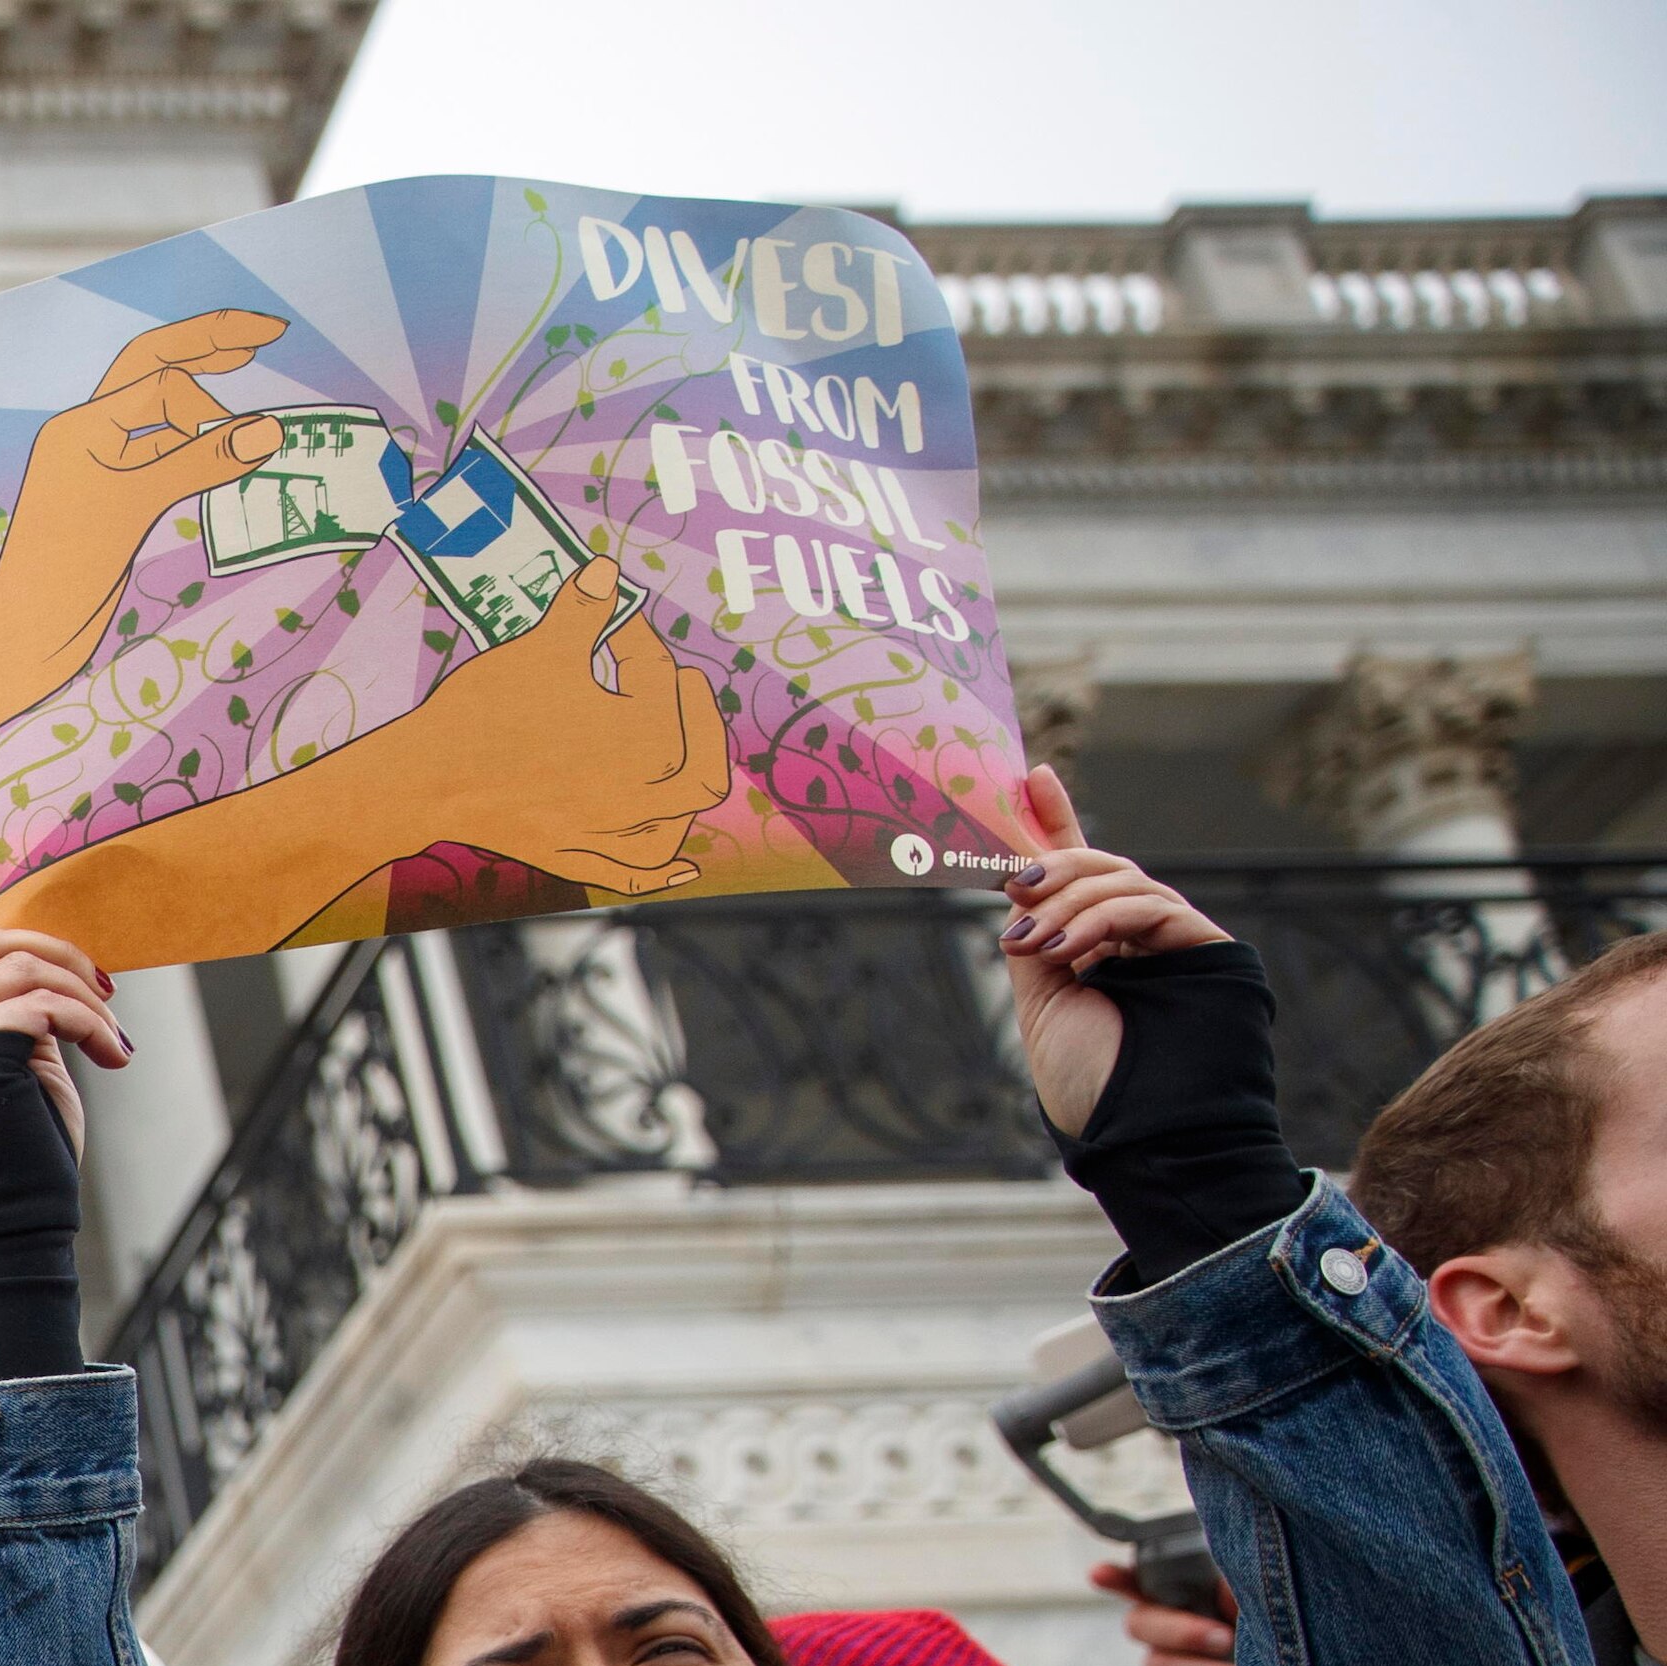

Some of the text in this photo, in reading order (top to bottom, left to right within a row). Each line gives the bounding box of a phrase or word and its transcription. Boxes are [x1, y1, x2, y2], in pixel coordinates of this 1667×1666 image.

[578, 216, 912, 347] DIVEST
[729, 352, 924, 454] FROM
[650, 423, 947, 551] FOSSIL
[715, 529, 970, 642] FUELS
